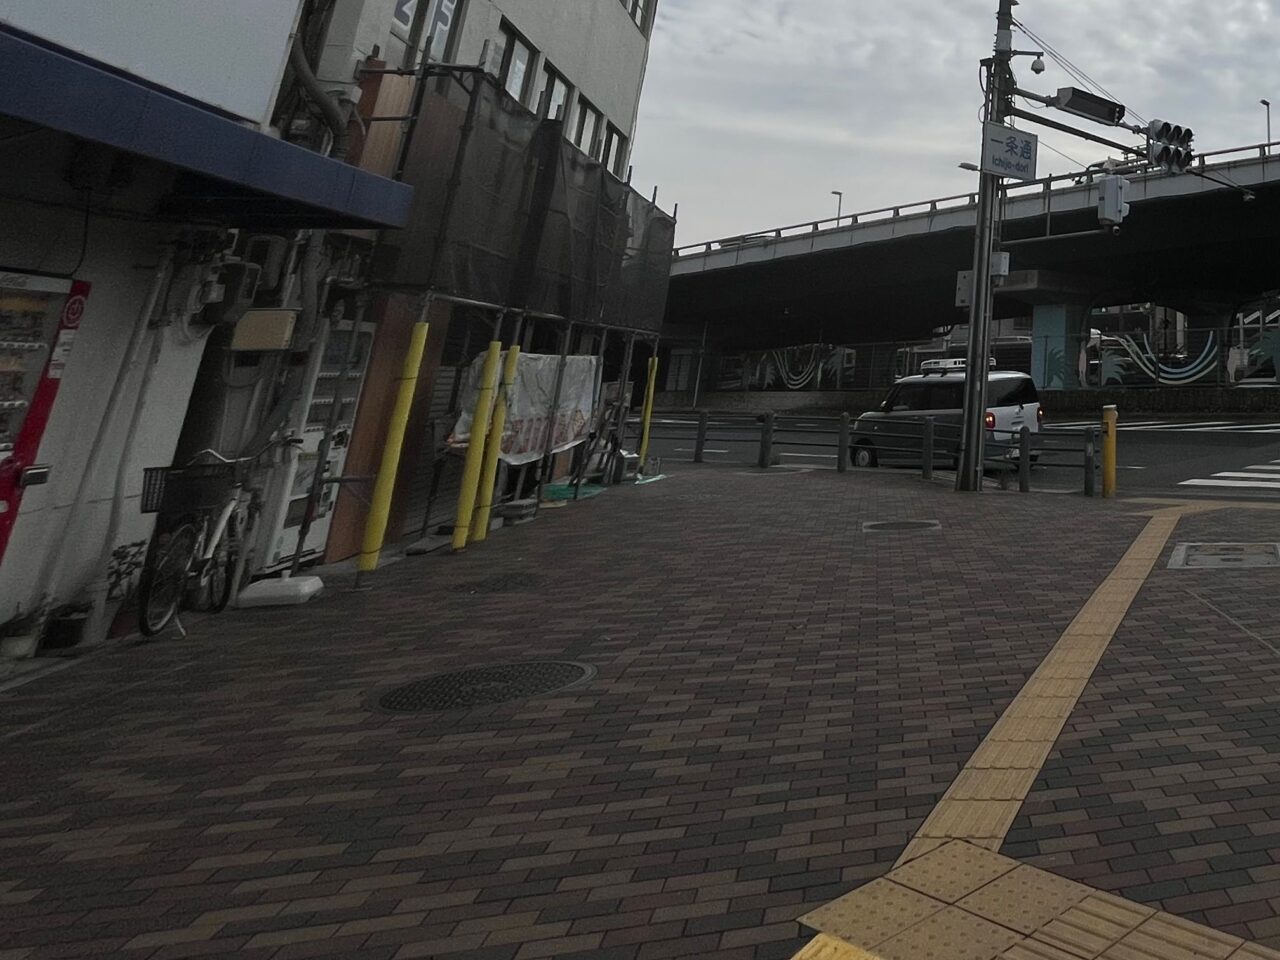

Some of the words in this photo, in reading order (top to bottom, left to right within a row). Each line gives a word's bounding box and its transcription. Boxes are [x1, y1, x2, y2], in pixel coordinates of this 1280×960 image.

[991, 136, 1032, 160] 一条通
[992, 155, 1029, 173] Ichijo-dori
